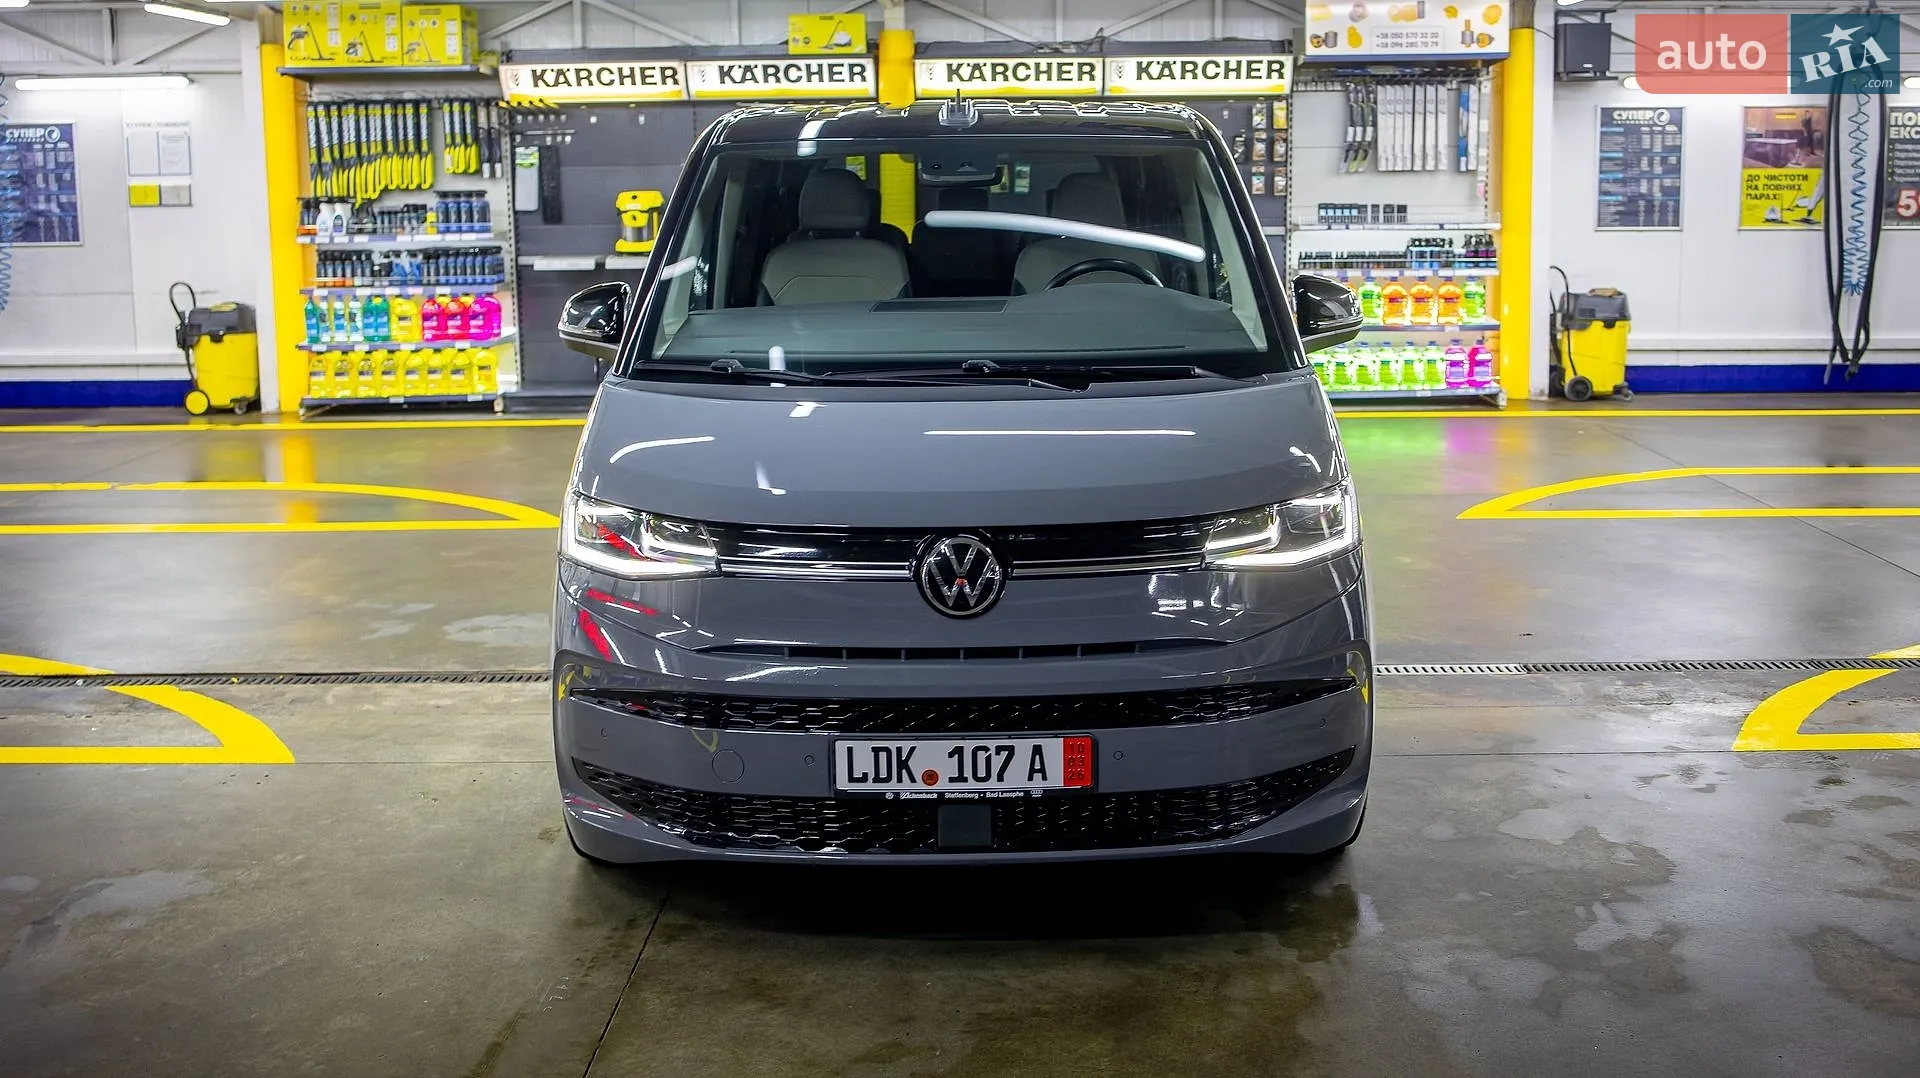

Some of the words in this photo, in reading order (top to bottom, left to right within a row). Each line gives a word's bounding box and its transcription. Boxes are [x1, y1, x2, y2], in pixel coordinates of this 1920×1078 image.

[531, 66, 680, 88] KÄRCHER
[718, 62, 868, 84] KÄRCHER
[946, 61, 1097, 82] KÄRCHER
[1135, 59, 1286, 81] KÄRCHER
[1612, 110, 1655, 120] СУПЕР
[1889, 112, 1920, 126] ПО
[6, 127, 45, 138] СУПЕР
[1746, 174, 1761, 182] ДО
[1763, 174, 1809, 182] ЧИСТОТИ
[1745, 183, 1760, 191] НА
[1762, 183, 1802, 191] ПОВНИХ
[846, 745, 918, 784] LDK
[947, 744, 1016, 783] 107
[1027, 743, 1049, 782] A
